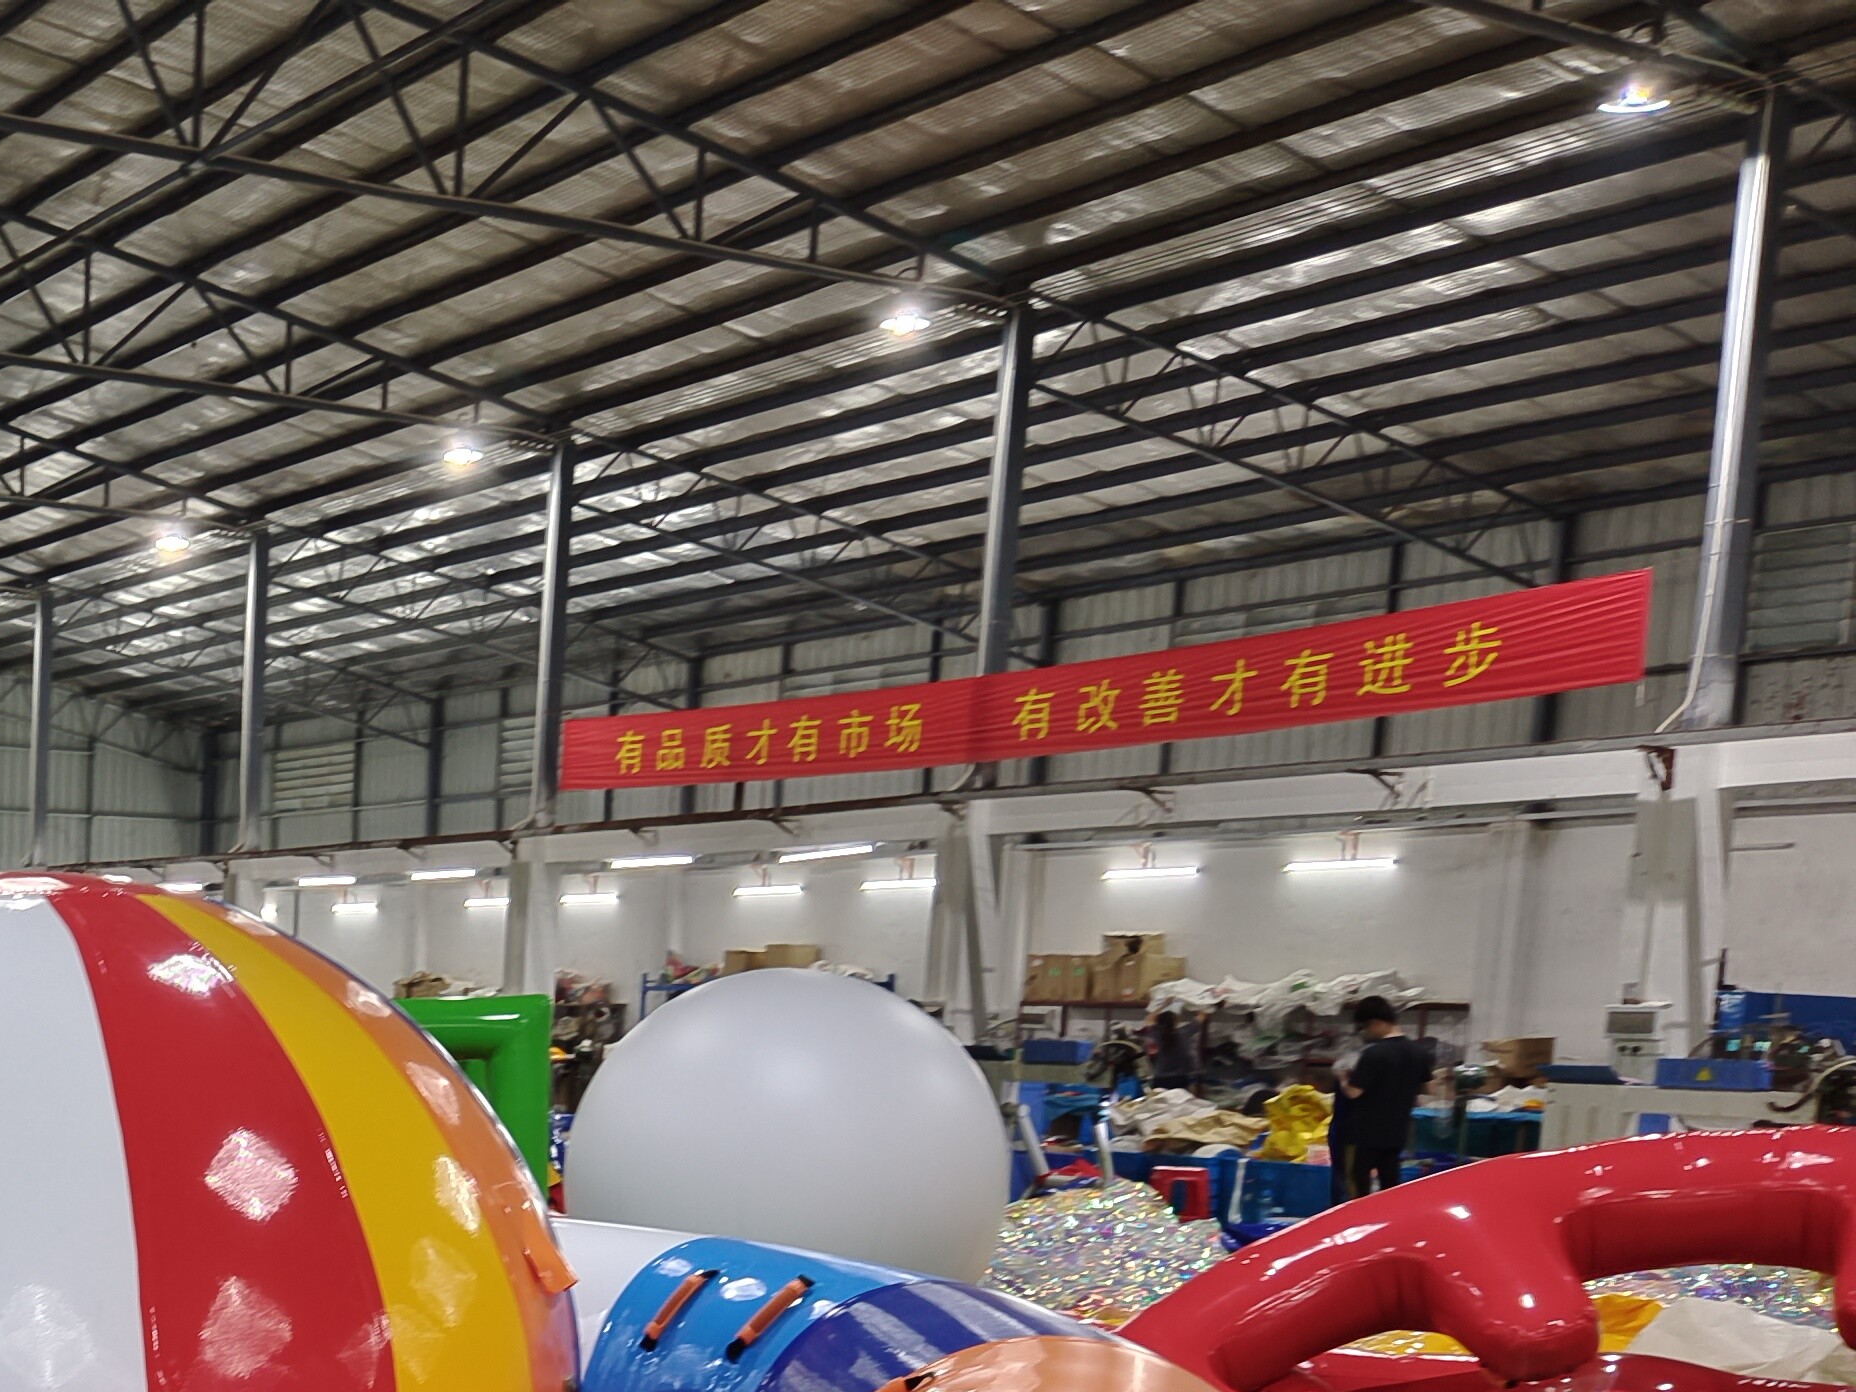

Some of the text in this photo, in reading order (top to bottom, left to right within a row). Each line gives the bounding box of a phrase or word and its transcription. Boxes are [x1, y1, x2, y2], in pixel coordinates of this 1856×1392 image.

[615, 621, 1504, 775] 有品质才有市场 有改善才有进步
